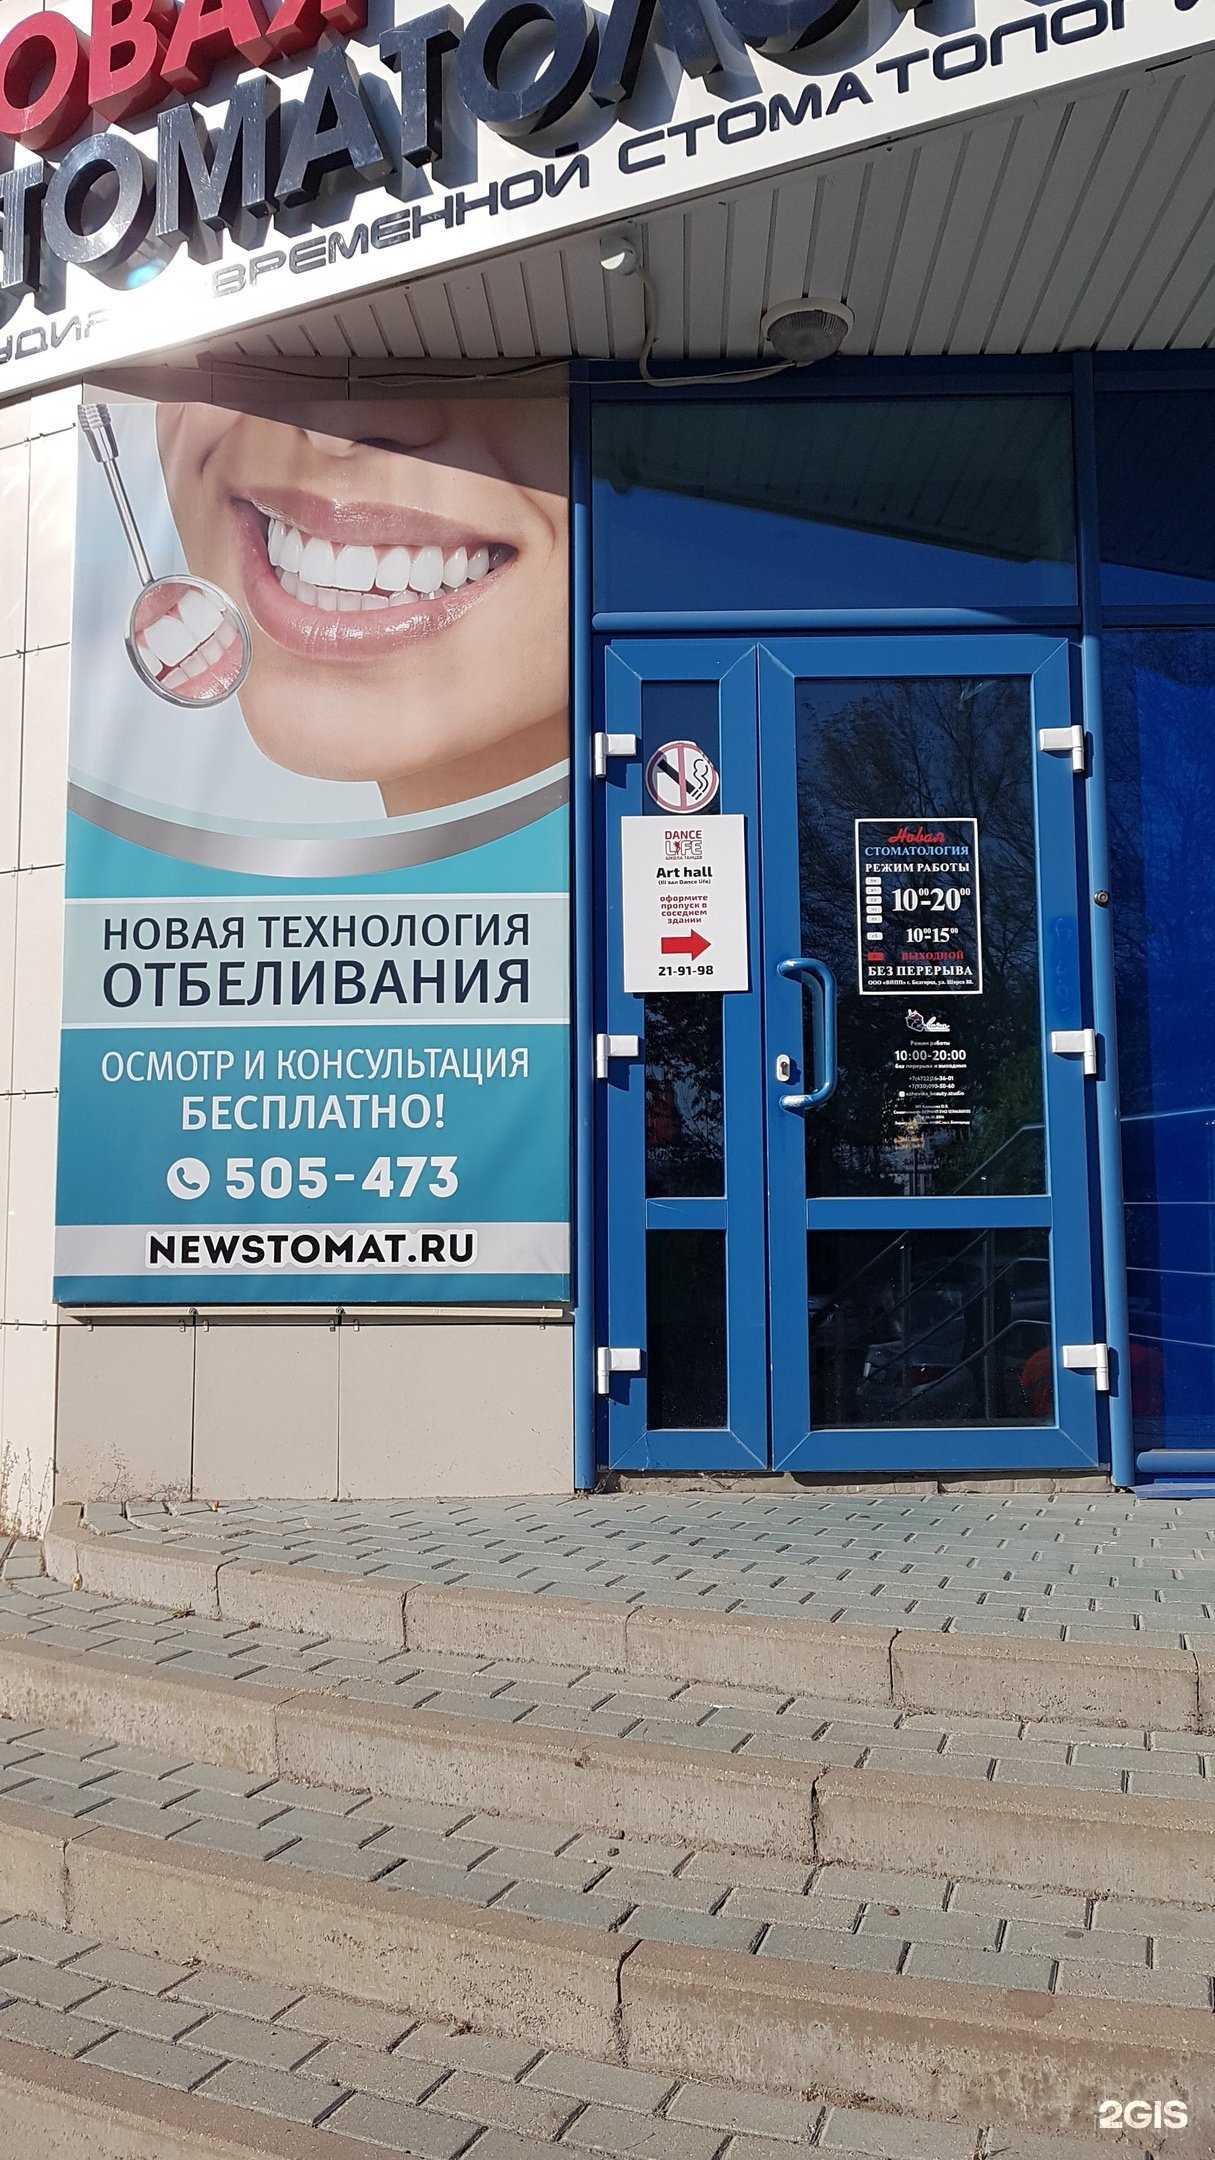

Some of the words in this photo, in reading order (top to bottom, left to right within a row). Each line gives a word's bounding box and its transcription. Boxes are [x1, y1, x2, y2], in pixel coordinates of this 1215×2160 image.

[0, 0, 362, 140] ОВА
[617, 0, 1200, 175] СТОМАТОЛО
[665, 830, 702, 840] DANCE
[864, 846, 969, 856] СТОМАТОЛОГИЯ
[656, 867, 680, 878] Art
[683, 866, 712, 878] hall
[865, 863, 914, 873] РЕЖИМ
[917, 862, 970, 872] РАБОТЫ
[659, 895, 708, 903] оформите
[104, 917, 245, 950] НОВАЯ
[257, 913, 530, 948] ТЕХНОЛОГИЯ
[658, 965, 714, 976] 21-91-98
[868, 966, 893, 976] БЕЗ
[896, 966, 973, 976] ПЕРЕРЫВА
[103, 958, 530, 1008] ОТБЕЛИВАНИЯ
[894, 1049, 967, 1061] 10:00-20:00
[101, 1049, 235, 1082] ОСМОТР
[244, 1051, 265, 1080] И
[277, 1047, 530, 1085] КОНСУЛЬТАЦИЯ
[182, 1093, 446, 1131] БЕСПЛАТНО!
[225, 1156, 459, 1199] 505-473
[149, 1234, 474, 1265] NEWSTOMAT.RU
